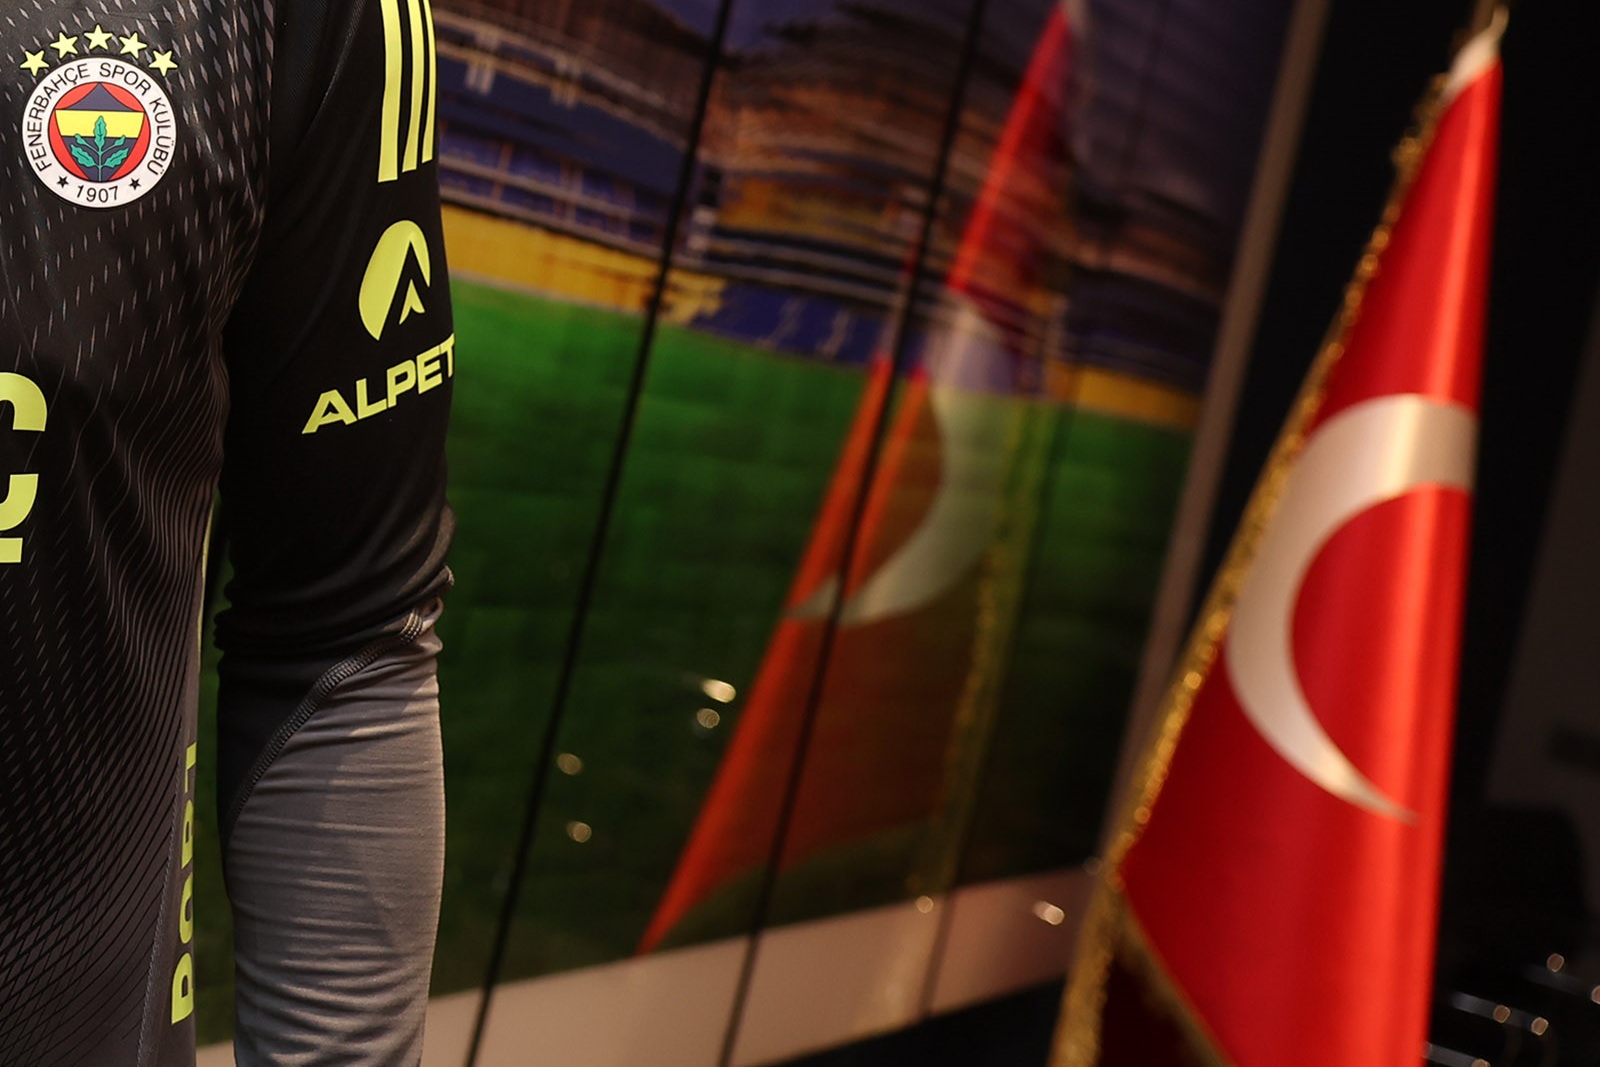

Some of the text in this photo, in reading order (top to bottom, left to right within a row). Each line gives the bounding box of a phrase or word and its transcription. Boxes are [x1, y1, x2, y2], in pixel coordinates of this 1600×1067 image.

[26, 62, 175, 176] FENERBAHÇE SPOR KULÜBÜ
[75, 184, 119, 203] 1907
[301, 333, 455, 435] ALPET
